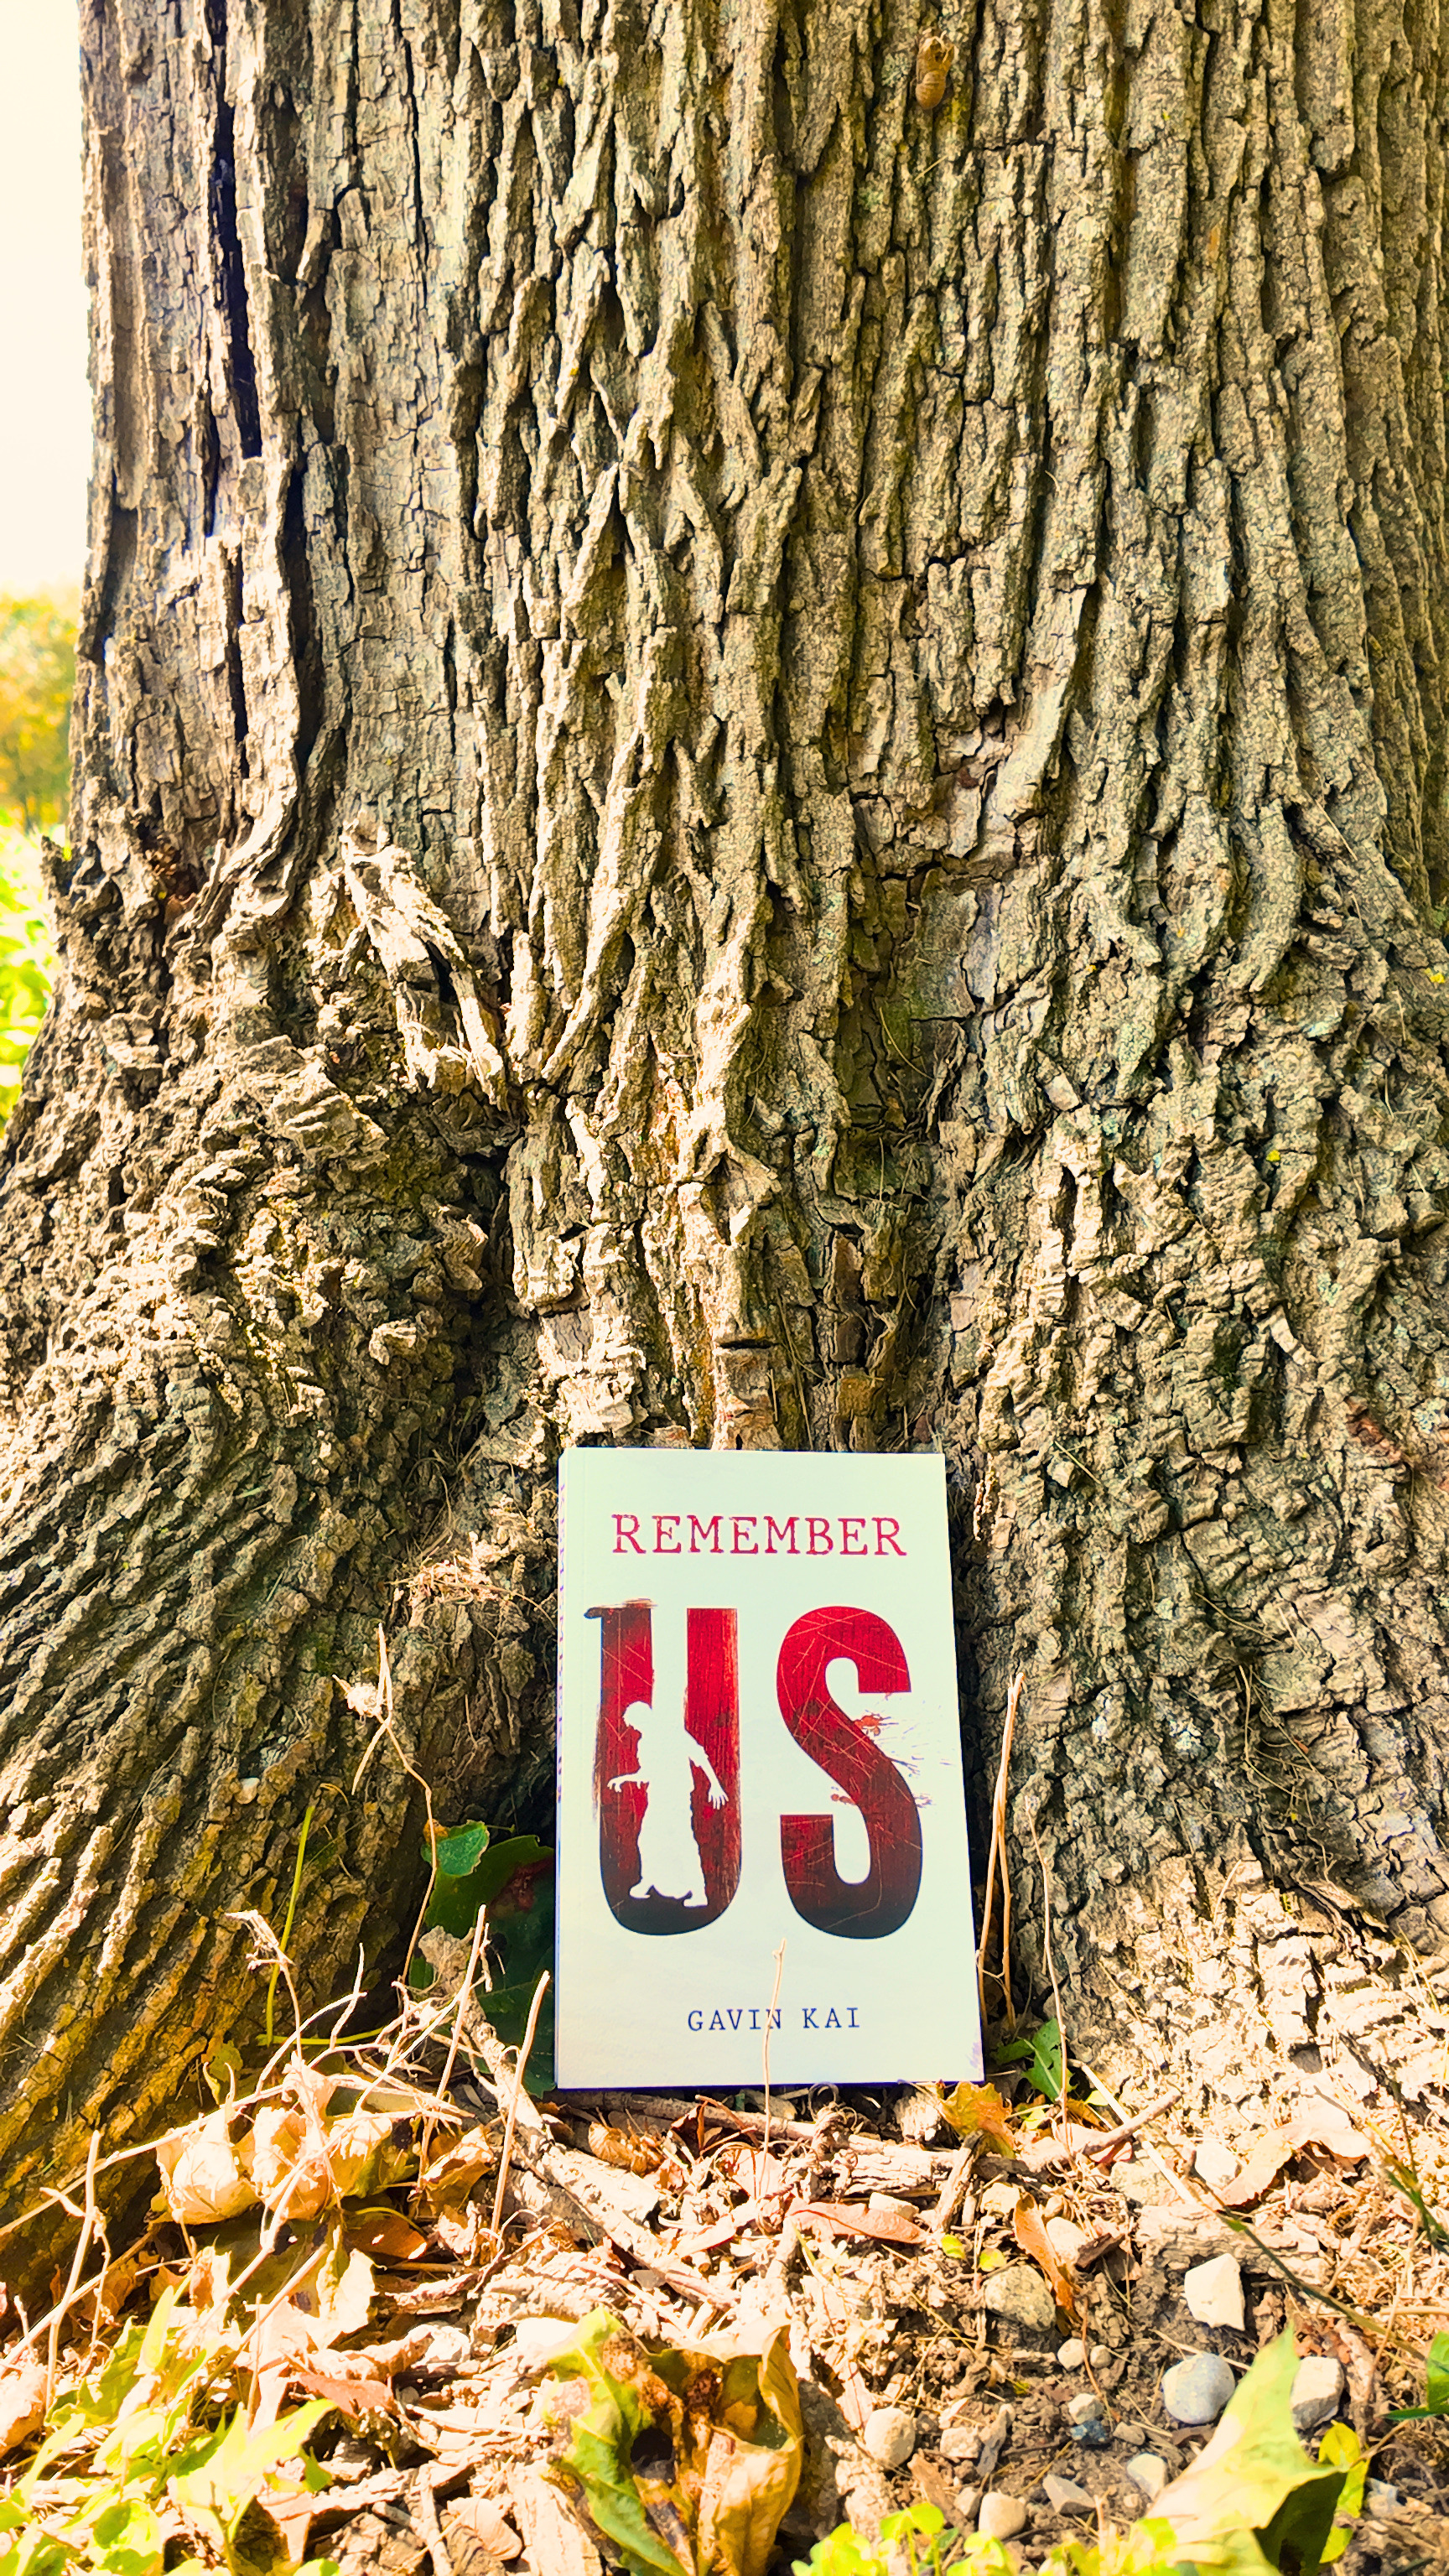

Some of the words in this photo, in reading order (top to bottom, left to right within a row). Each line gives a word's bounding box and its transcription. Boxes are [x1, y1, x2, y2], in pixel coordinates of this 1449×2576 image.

[610, 1513, 908, 1556] REMEMBER
[587, 1600, 923, 1940] US
[687, 2008, 782, 2032] GAVIN
[802, 2007, 860, 2029] KAI
